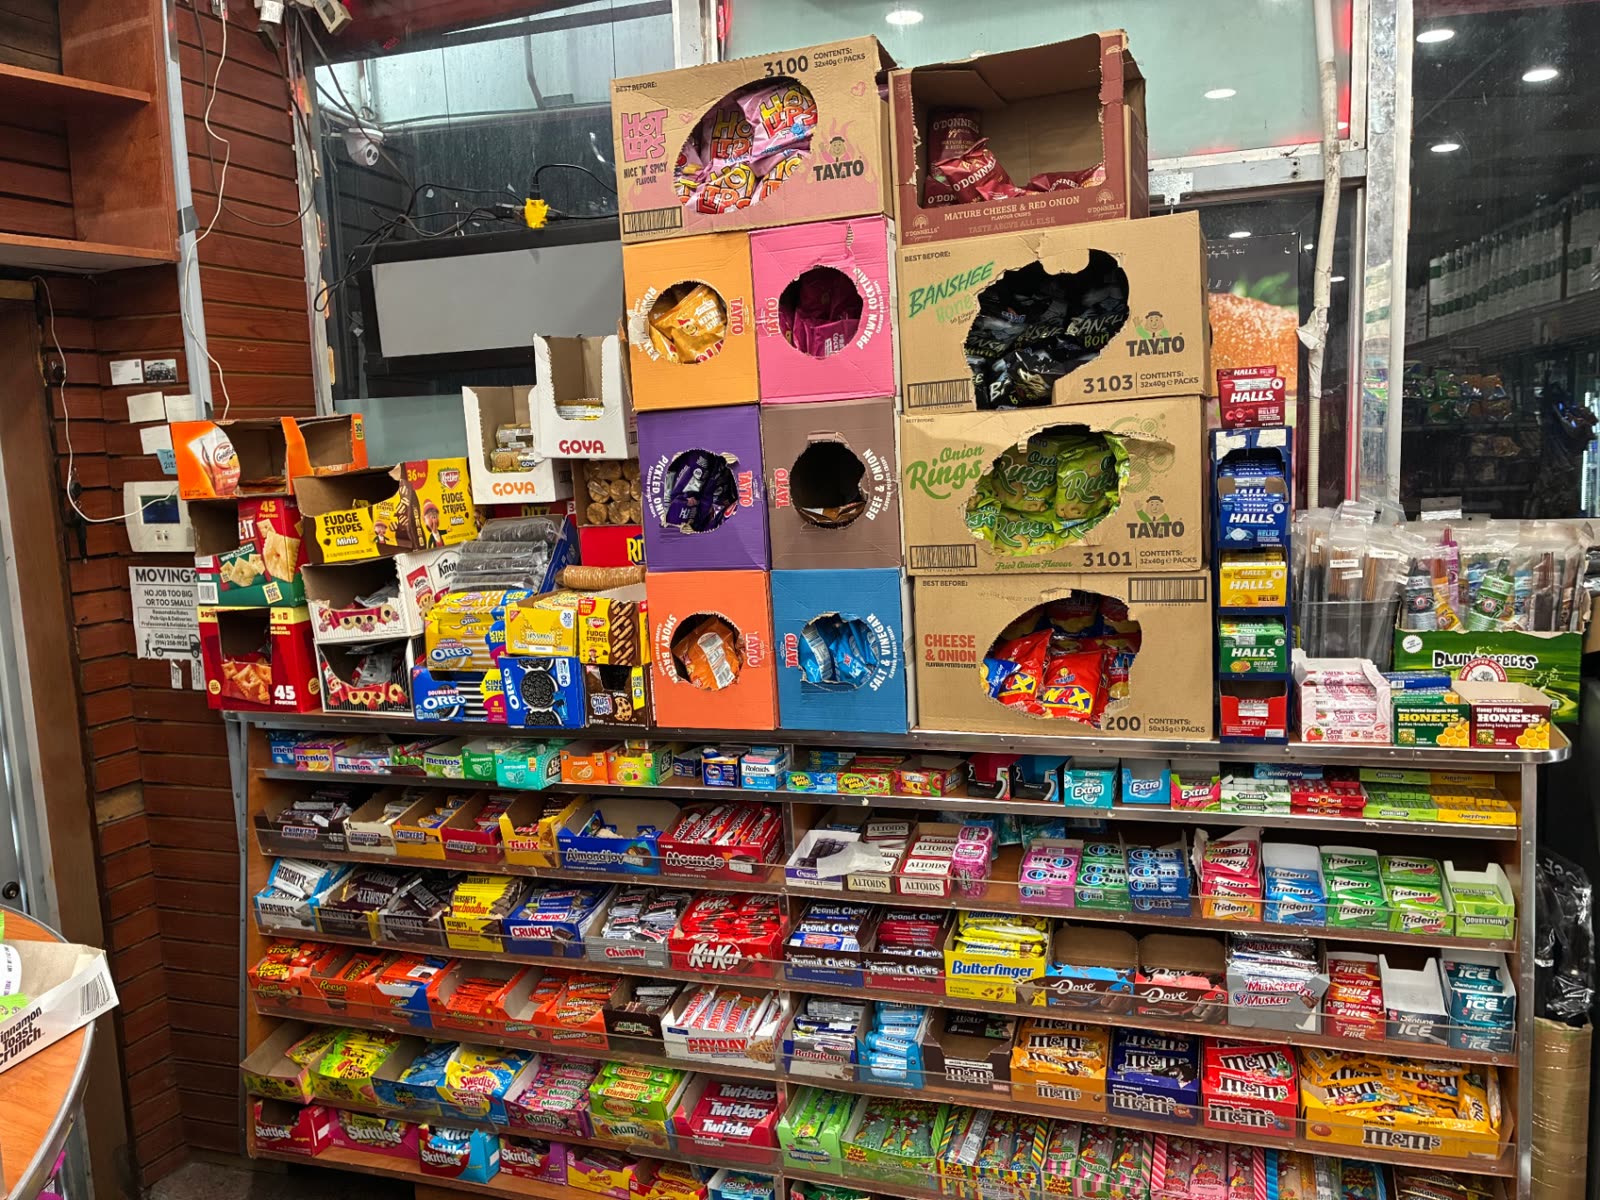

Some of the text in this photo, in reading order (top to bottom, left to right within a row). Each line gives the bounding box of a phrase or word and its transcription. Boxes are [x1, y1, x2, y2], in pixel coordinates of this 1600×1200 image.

[814, 47, 852, 59] CONTENTS:
[764, 56, 808, 77] 3100
[621, 109, 668, 137] HOT
[622, 134, 667, 162] LIPS
[813, 159, 864, 182] TAYTO
[969, 224, 991, 234] TASTE
[1020, 219, 1033, 228] ALL
[1035, 216, 1055, 226] ELSE
[926, 252, 950, 261] BEFORE:
[908, 261, 995, 319] BANSHEE
[1126, 338, 1185, 357] TAYTO
[1140, 371, 1184, 380] CONTENTS:
[1174, 376, 1198, 385] PACKS
[1083, 375, 1132, 394] 3103
[559, 440, 604, 454] GOYA
[940, 444, 984, 462] Onion
[863, 448, 882, 482] ONION
[651, 455, 669, 495] PICKLED
[906, 458, 982, 500] Rings
[492, 482, 535, 496] GOYA
[441, 493, 464, 503] FUDGE
[260, 502, 276, 513] 45
[442, 504, 466, 515] STRIPES
[569, 503, 574, 512] 3
[865, 493, 883, 520] BEEF
[324, 512, 359, 525] FUDGE
[325, 522, 362, 536] STRIPES
[1127, 522, 1185, 538] TAYTO
[336, 536, 358, 546] Minis
[1083, 552, 1132, 567] 3101
[1140, 550, 1182, 558] CONTENTS:
[136, 569, 197, 583] MOVING?
[867, 613, 891, 656] VINEGAR
[925, 634, 975, 648] CHEESE
[431, 647, 473, 662] OREO
[661, 614, 678, 684] SMOKY BACON
[926, 649, 976, 662] & ONION
[870, 668, 885, 691] SALT
[274, 685, 296, 700] 45
[504, 668, 519, 710] OREO
[423, 695, 466, 710] OREO
[1398, 713, 1459, 722] HONEES
[1477, 714, 1540, 722] HONEES
[426, 757, 460, 765] mentos
[995, 768, 1008, 799] 5
[1132, 781, 1159, 793] Extra
[1073, 785, 1102, 797] Extra
[1182, 788, 1209, 799] Extra
[870, 824, 906, 832] ALTOIDS
[396, 831, 424, 840] SNICKERS
[508, 839, 538, 850] Twix
[915, 844, 952, 852] ALTOIDS
[566, 848, 607, 862] Almond
[666, 852, 724, 868] Mounds
[1326, 857, 1367, 866] Trident
[1388, 861, 1429, 869] Trident
[277, 864, 307, 887] HERSHEY'S
[852, 878, 886, 888] ALTOIDS
[904, 881, 940, 892] ALTOIDS
[1328, 879, 1371, 888] Trident
[1272, 886, 1313, 895] Trident
[1391, 889, 1432, 898] Trident
[454, 895, 476, 904] HERSHEY'S
[810, 906, 839, 915] Peanut
[800, 923, 858, 932] Peanut Chews
[1465, 917, 1506, 926] DOUBLEMINT
[512, 925, 553, 938] CRUNCH
[605, 946, 645, 958] Chunky
[690, 941, 742, 970] KitKat
[952, 960, 1034, 978] Butterfinger
[1335, 965, 1367, 974] FIRE
[1458, 969, 1490, 980] ICE
[1051, 980, 1096, 994] Dove
[1140, 988, 1188, 1003] Dove
[1466, 999, 1498, 1010] ICE
[1400, 1016, 1434, 1025] Dentyne
[1470, 1012, 1491, 1021] ICE
[0, 1006, 42, 1043] innamon
[1398, 1024, 1434, 1037] ICE
[1342, 1030, 1366, 1038] FIRE
[688, 1038, 747, 1053] PAYDAY
[617, 1067, 651, 1079] Starburst
[460, 1076, 496, 1090] Swedish
[556, 1078, 587, 1088] Mamba
[616, 1080, 649, 1092] Starburst
[604, 1088, 639, 1100] Starburst
[462, 1098, 480, 1107] Fish
[710, 1102, 768, 1120] Twizzlers
[1209, 1104, 1275, 1127] m&m's
[526, 1113, 563, 1128] Mamba
[255, 1126, 291, 1139] Skittles
[347, 1125, 402, 1144] Skittles
[1363, 1127, 1440, 1150] m&m's
[422, 1150, 461, 1167] Skittles
